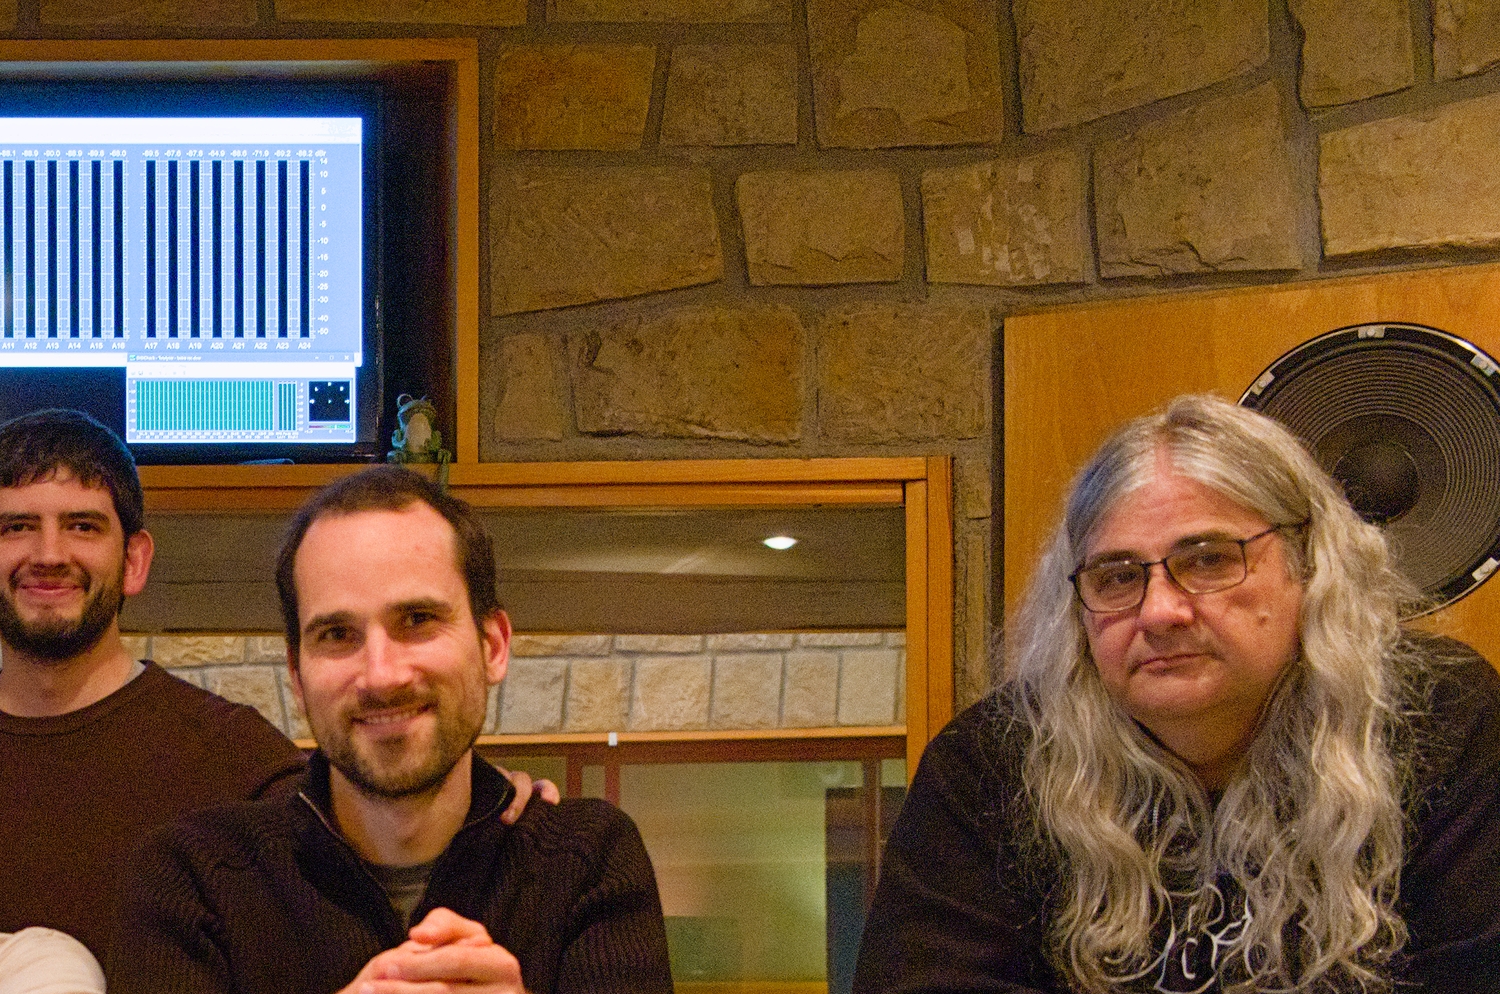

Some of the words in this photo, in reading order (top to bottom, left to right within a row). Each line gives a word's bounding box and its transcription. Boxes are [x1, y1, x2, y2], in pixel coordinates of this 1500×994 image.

[1, 342, 15, 350] A11
[23, 342, 38, 350] A12
[45, 342, 60, 350] A13
[67, 342, 82, 350] A14
[144, 342, 159, 350] A17
[210, 342, 225, 350] A20
[231, 342, 246, 350] A21
[253, 342, 268, 350] A22
[275, 342, 290, 350] A23
[297, 342, 312, 350] A24
